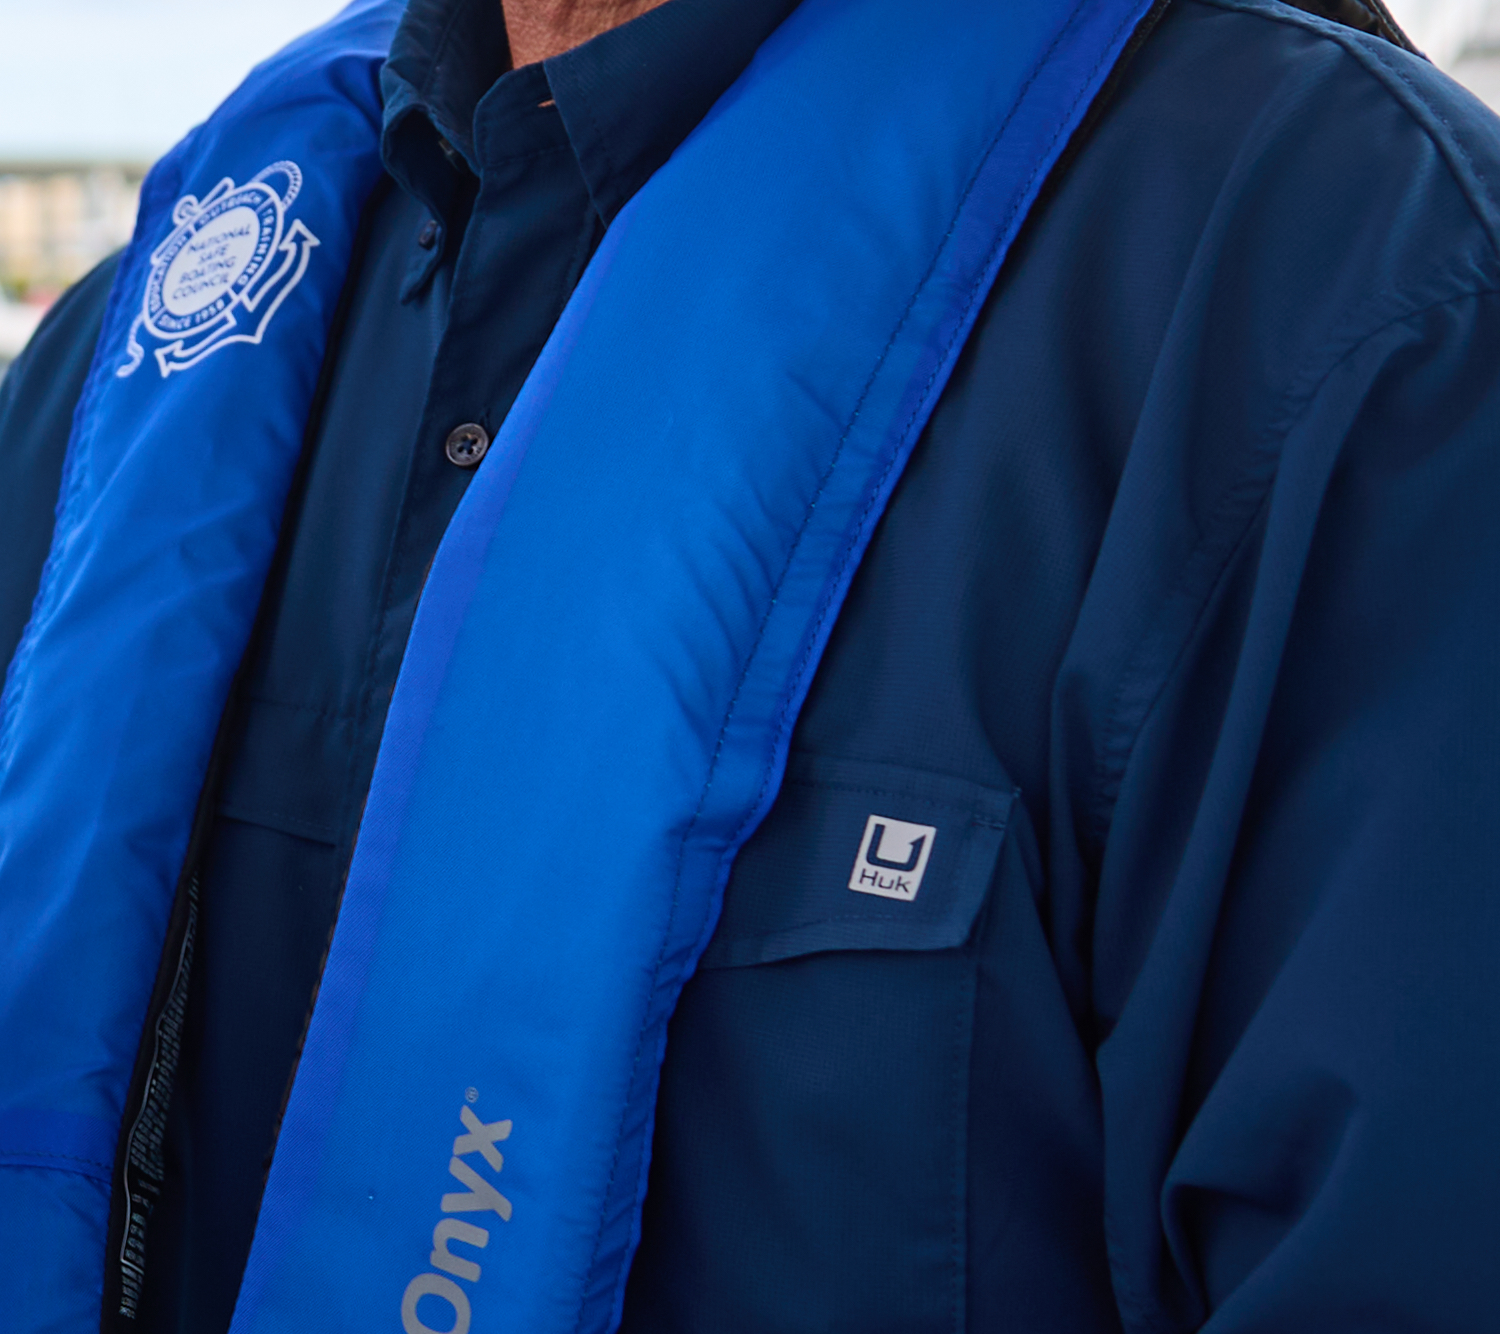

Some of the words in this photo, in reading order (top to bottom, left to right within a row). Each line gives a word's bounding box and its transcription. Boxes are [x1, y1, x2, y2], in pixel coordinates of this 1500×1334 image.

[187, 224, 251, 254] NATIONAL
[237, 208, 274, 285] TRAINING
[199, 244, 229, 263] SAFE
[179, 256, 236, 283] BOATING
[172, 273, 228, 299] COUNCIL
[859, 868, 912, 894] Huk
